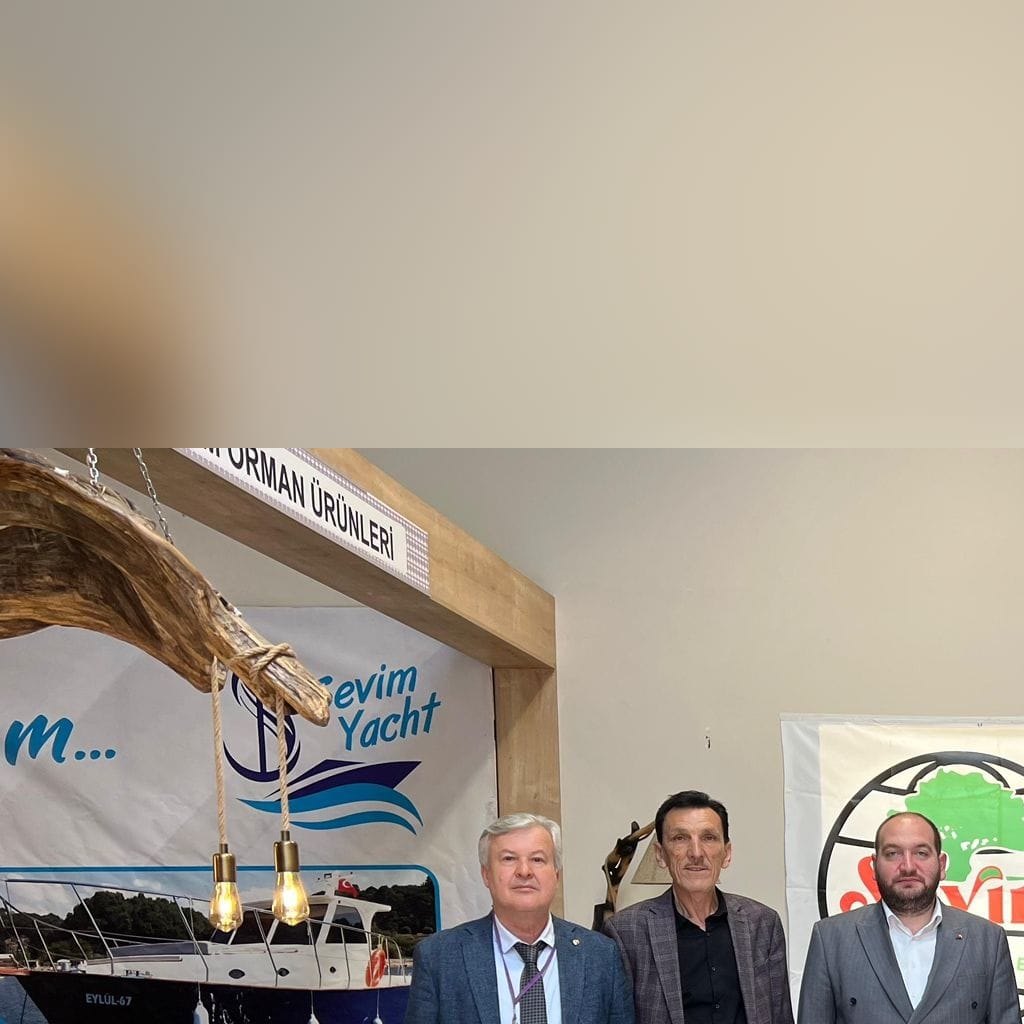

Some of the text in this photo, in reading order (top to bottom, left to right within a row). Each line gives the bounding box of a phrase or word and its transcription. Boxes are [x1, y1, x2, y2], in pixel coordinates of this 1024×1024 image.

[310, 477, 394, 561] ÜRÜNLERİ
[319, 664, 417, 709] evim
[338, 692, 441, 751] Yacht
